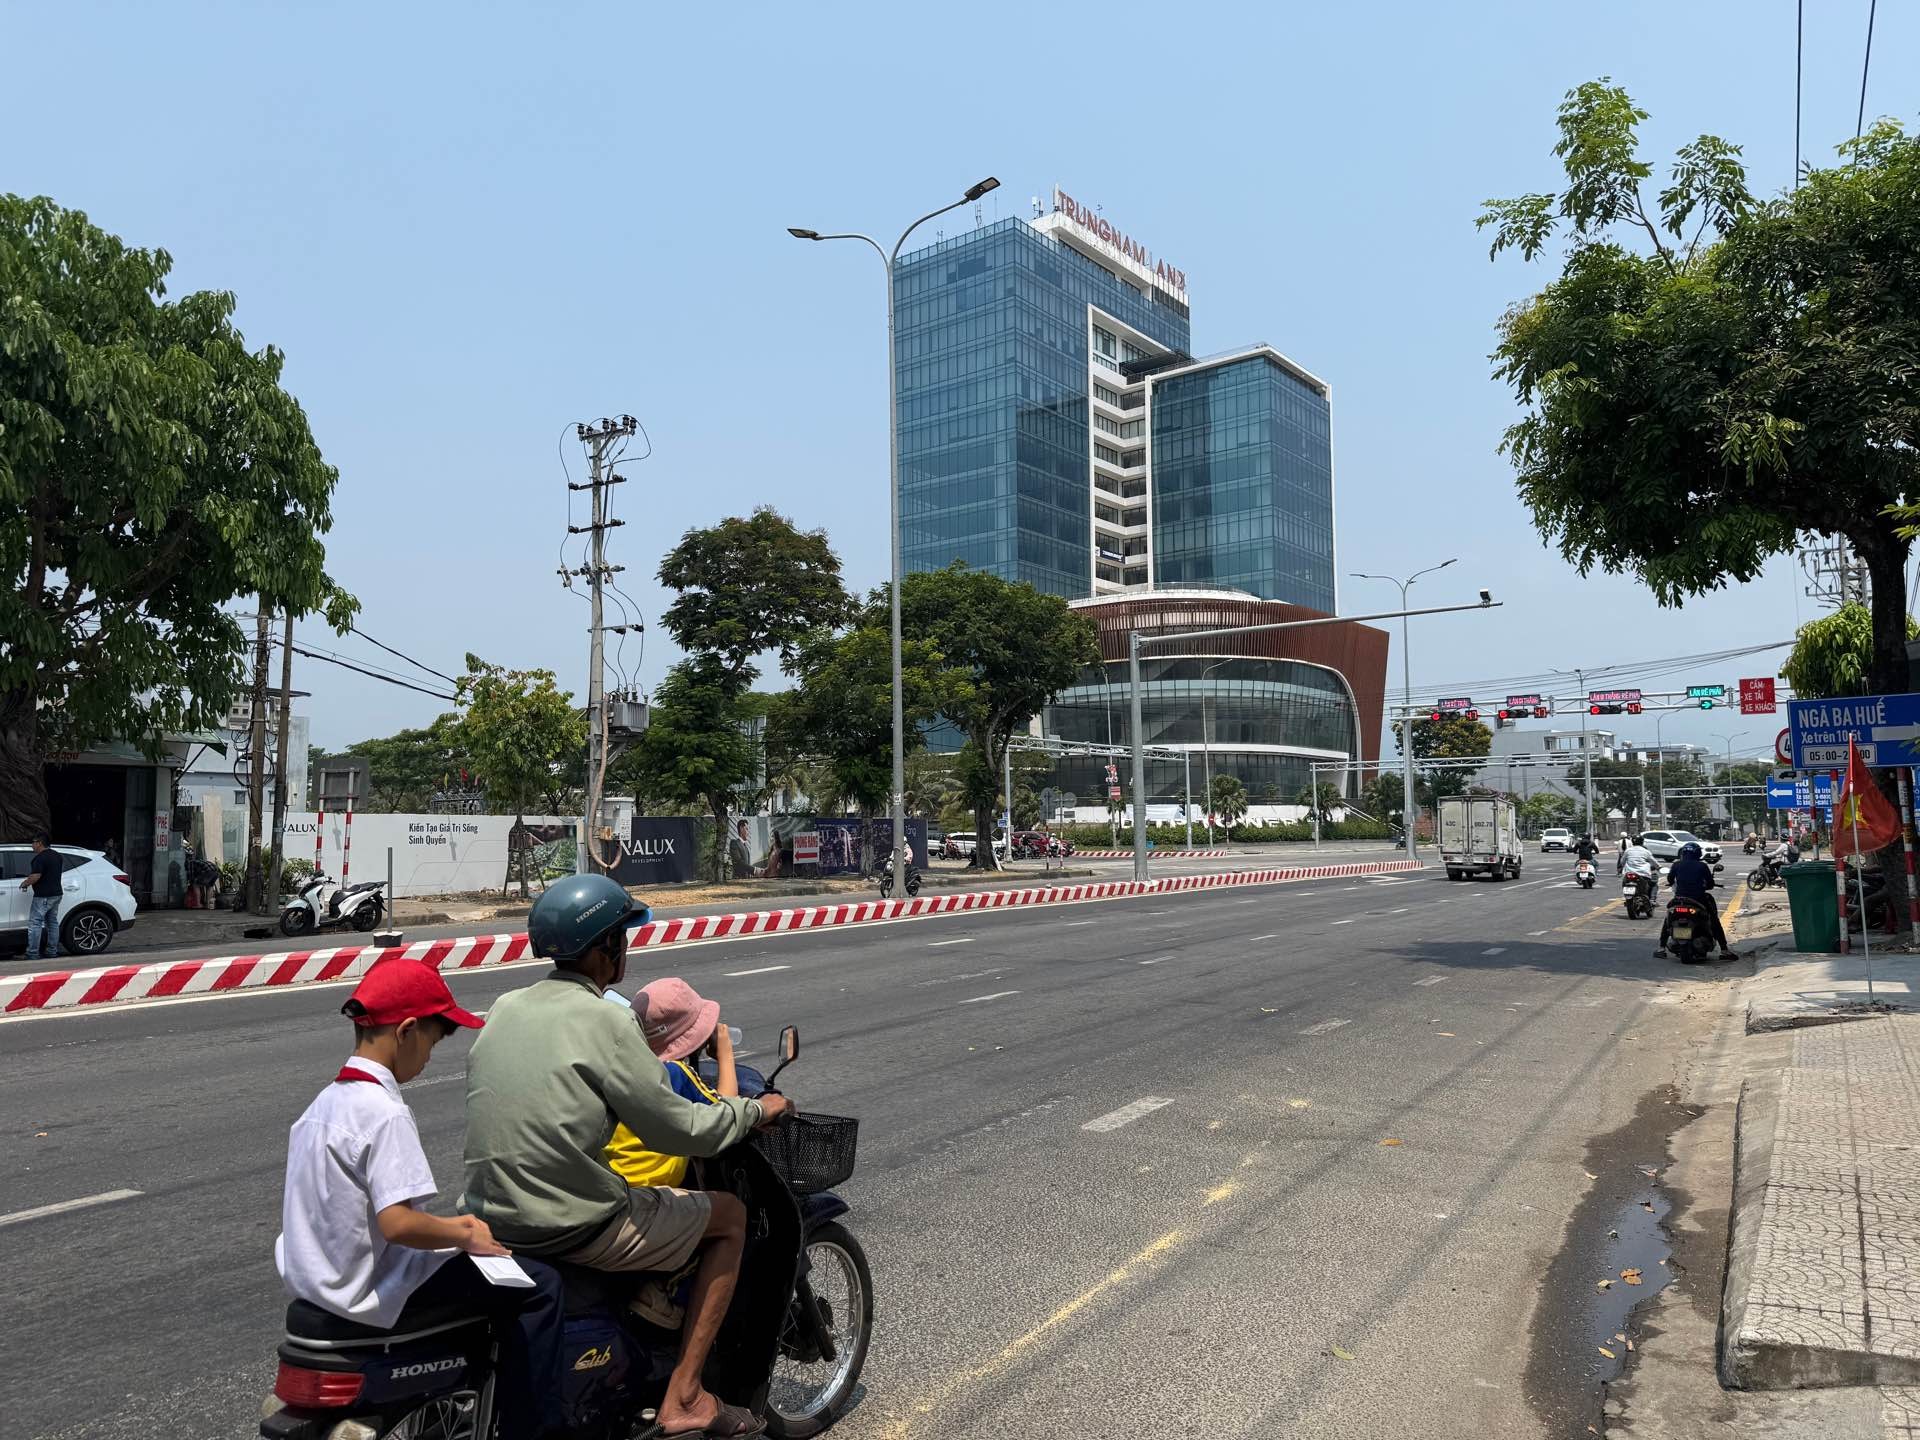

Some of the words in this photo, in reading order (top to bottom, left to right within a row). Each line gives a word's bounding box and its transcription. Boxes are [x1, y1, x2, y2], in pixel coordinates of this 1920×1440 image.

[1058, 190, 1145, 266] TRUNGNAM
[1466, 711, 1477, 719] 47
[1535, 708, 1546, 717] 47
[1629, 704, 1641, 712] 47
[1798, 704, 1830, 728] NGÃ
[1832, 707, 1853, 727] BA
[1855, 696, 1887, 725] HUẾ
[1801, 731, 1813, 744] Xe
[1813, 729, 1836, 742] trên
[408, 823, 425, 833] Kiến
[426, 823, 438, 834] Tạo
[439, 823, 451, 833] Giá
[451, 823, 461, 834] Trị
[462, 823, 478, 834] Sống
[408, 835, 424, 845] Sinh
[576, 899, 608, 924] HONDA
[571, 1345, 612, 1371] Cub
[390, 1356, 468, 1380] HONDA
